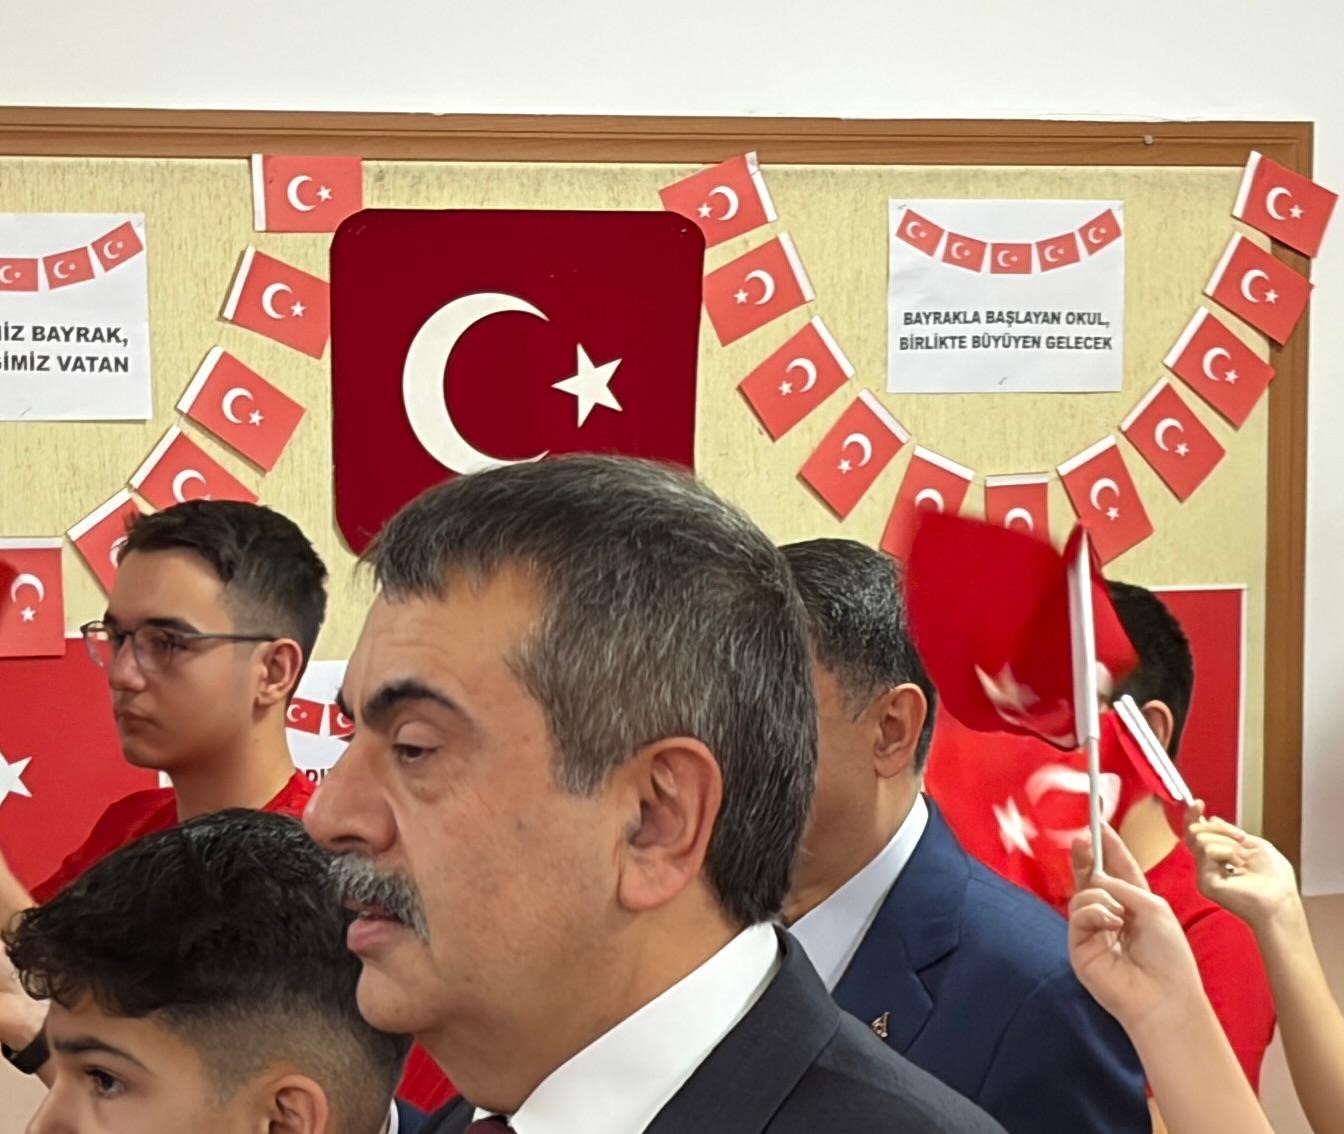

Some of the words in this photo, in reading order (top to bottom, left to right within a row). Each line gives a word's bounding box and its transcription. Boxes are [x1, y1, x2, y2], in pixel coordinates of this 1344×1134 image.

[903, 310, 982, 326] BAYRAKLA
[985, 310, 1062, 328] BAŞLAYAN
[1065, 311, 1110, 328] OKUL,
[31, 325, 129, 348] BAYRAK,
[899, 333, 967, 351] BİRLİKTE
[971, 332, 1042, 350] BÜYÜYEN
[1045, 335, 1113, 350] GELECEK
[56, 355, 129, 373] VATAN
